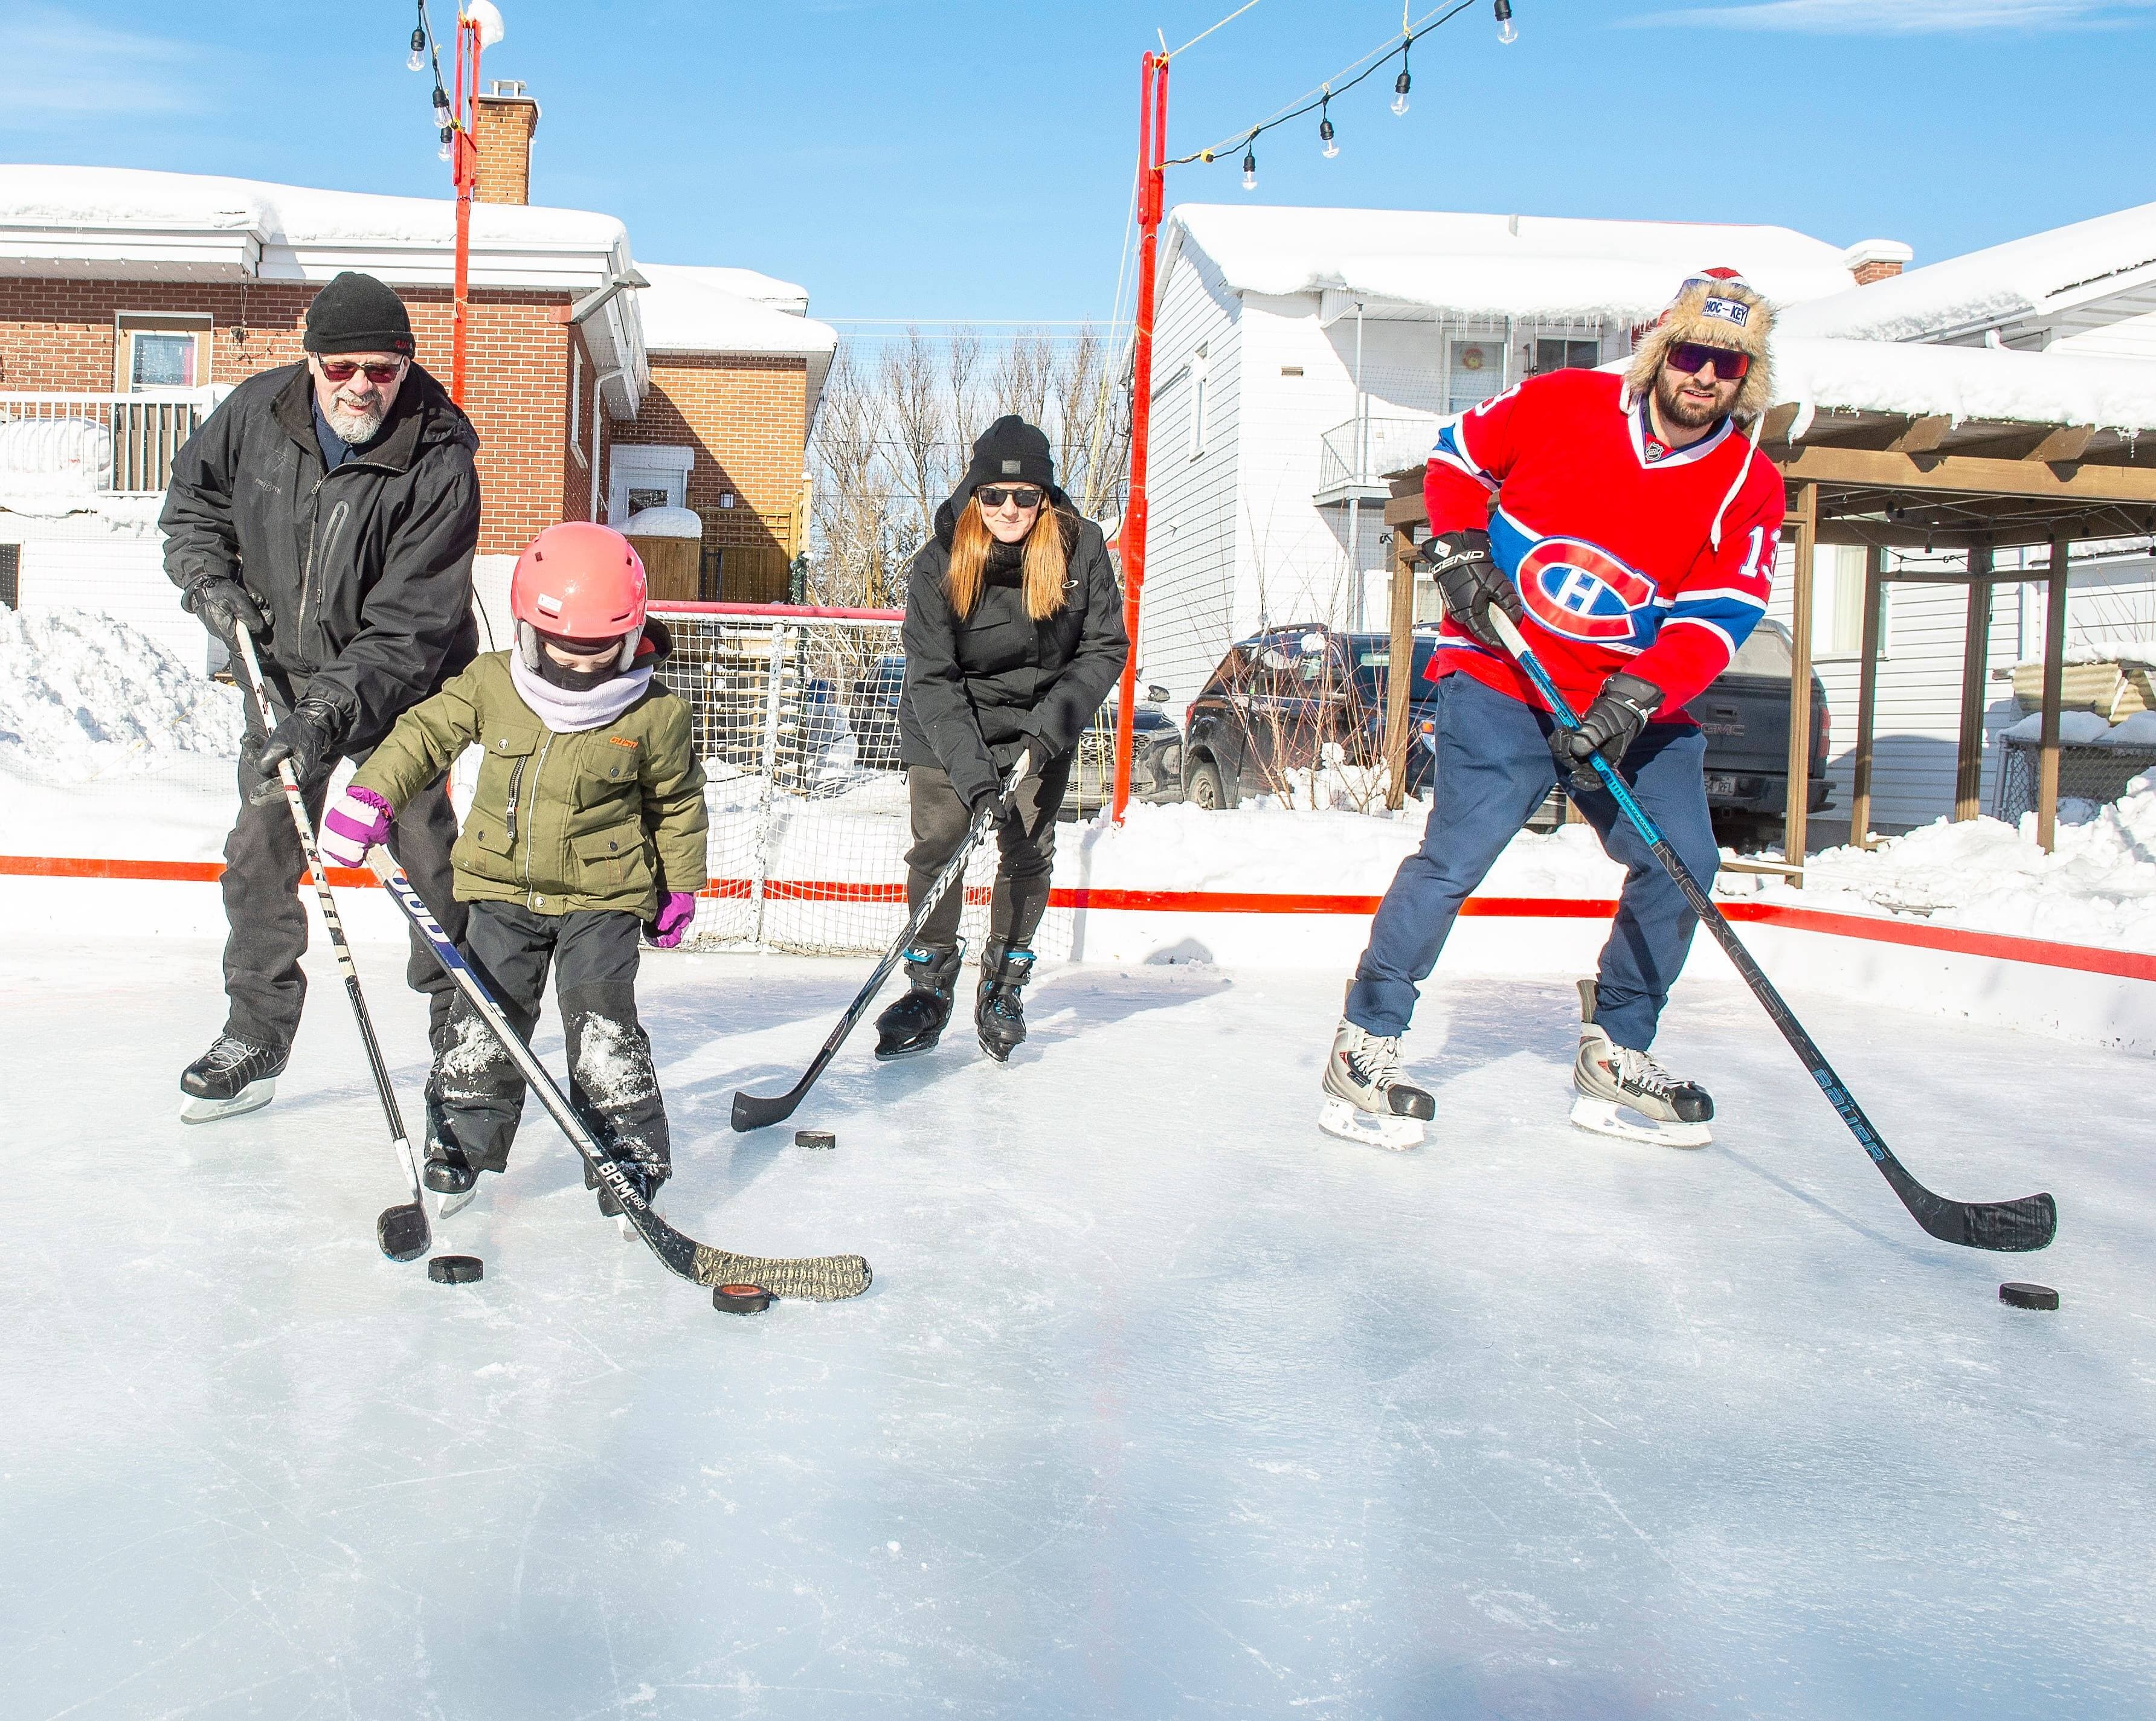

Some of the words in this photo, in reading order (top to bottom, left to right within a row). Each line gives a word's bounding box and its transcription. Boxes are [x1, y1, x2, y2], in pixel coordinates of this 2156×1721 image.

[1704, 301, 1723, 314] HOC
[1730, 305, 1749, 322] KEY
[1430, 550, 1484, 574] GEND
[1701, 722, 1745, 736] GMC
[598, 1160, 636, 1200] BPM
